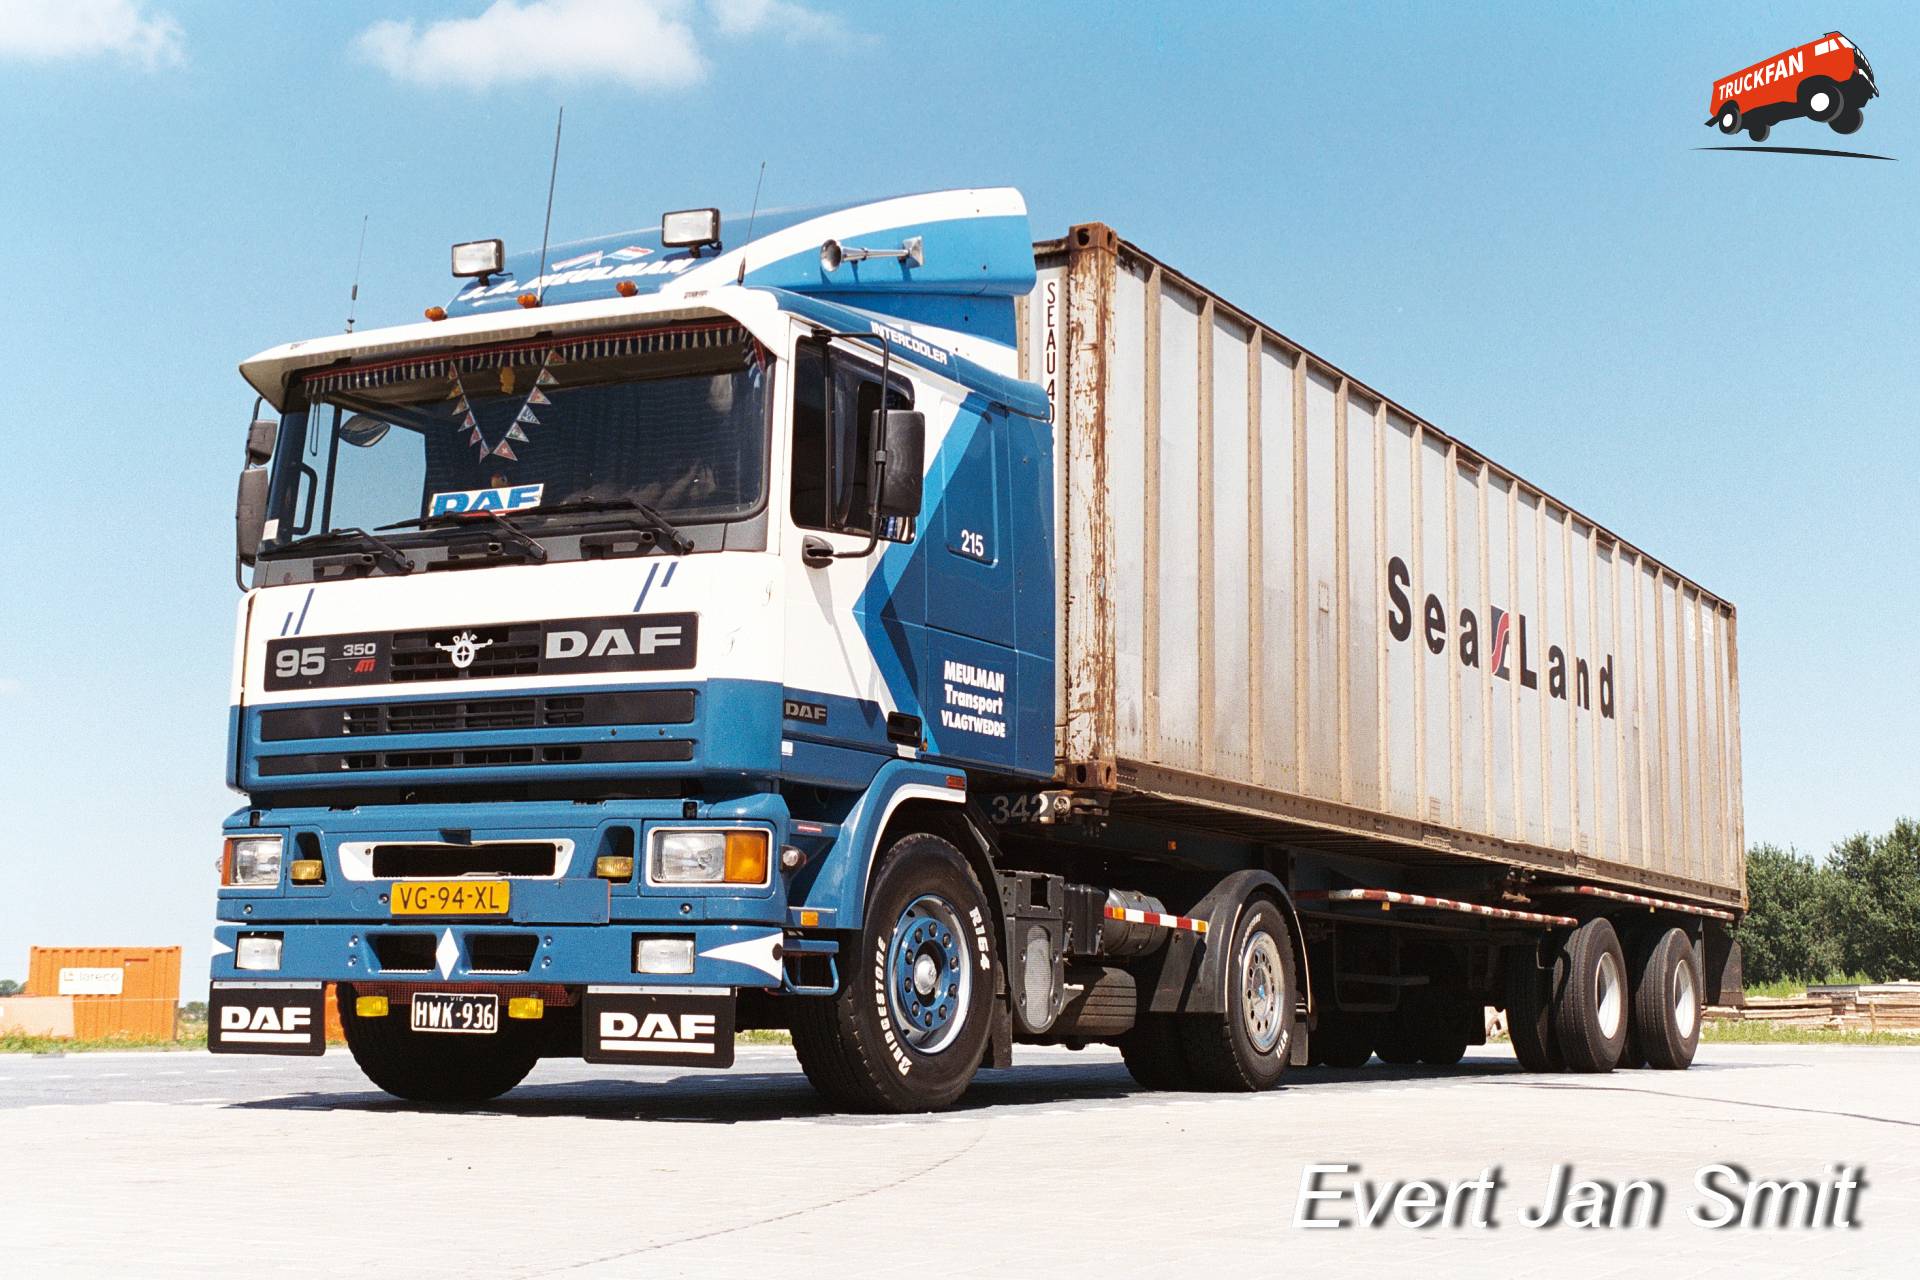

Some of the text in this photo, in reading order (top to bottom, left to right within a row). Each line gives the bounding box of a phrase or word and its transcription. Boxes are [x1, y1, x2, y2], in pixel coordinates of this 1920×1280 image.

[870, 320, 948, 365] INTERCOOLER
[432, 485, 541, 517] DAF
[961, 529, 984, 557] 215
[343, 642, 377, 657] 350
[452, 631, 478, 646] DAF
[545, 626, 682, 660] DAF
[275, 647, 326, 678] 95
[943, 659, 1005, 693] MEULMAN
[785, 702, 827, 720] DAF
[944, 683, 1004, 715] Transport
[941, 709, 1006, 738] VLAGTWEDDE
[400, 886, 500, 911] VG-94-XL
[220, 1006, 312, 1031] DAF
[874, 935, 913, 1077] BRIDGESTONE
[600, 1012, 716, 1040] DAF
